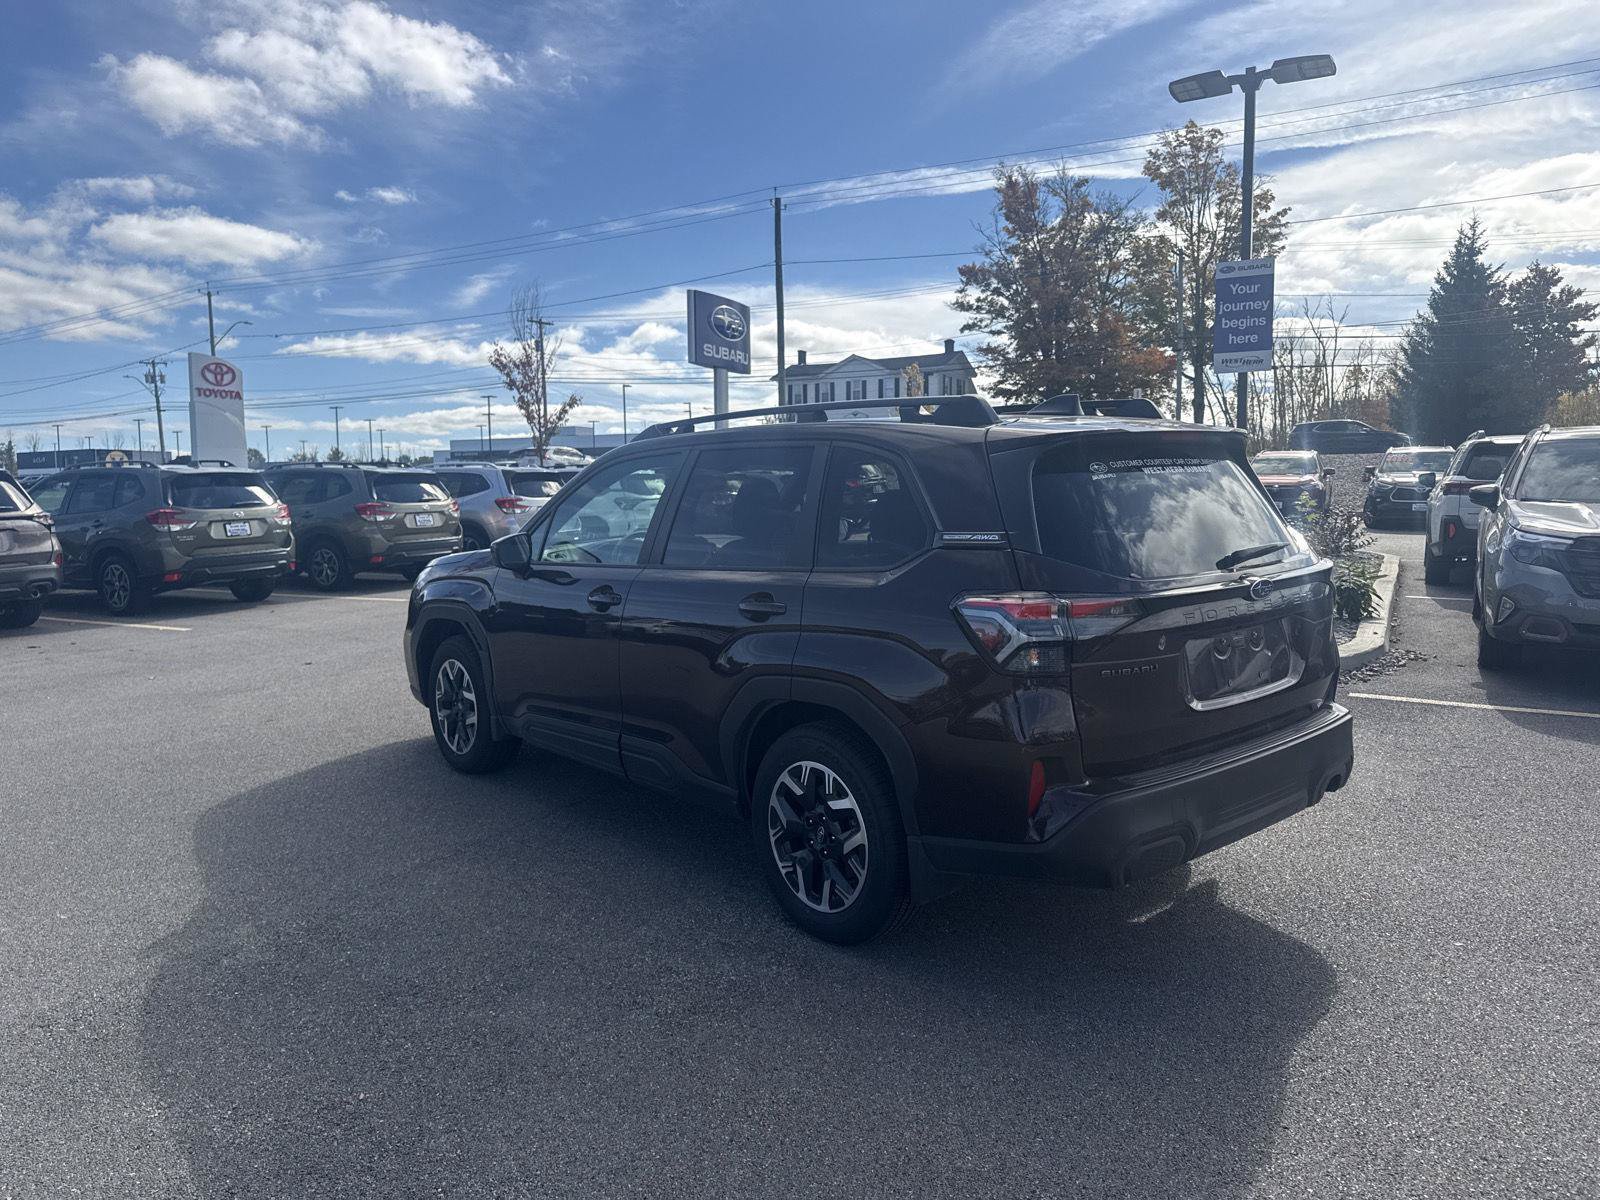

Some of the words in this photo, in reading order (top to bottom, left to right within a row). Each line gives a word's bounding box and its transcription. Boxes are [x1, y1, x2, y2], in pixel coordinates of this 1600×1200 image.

[1238, 263, 1272, 271] SUBARU
[1230, 283, 1261, 295] Your
[1218, 300, 1270, 315] journey
[1221, 316, 1267, 330] begins
[1228, 333, 1259, 345] here
[703, 344, 748, 365] SUBARU
[194, 387, 243, 401] TOYOTA
[1109, 460, 1143, 469] CUSTOMER
[1142, 466, 1164, 475] WEST
[1091, 472, 1117, 481] SUBARU
[1101, 664, 1159, 678] SUBARU
